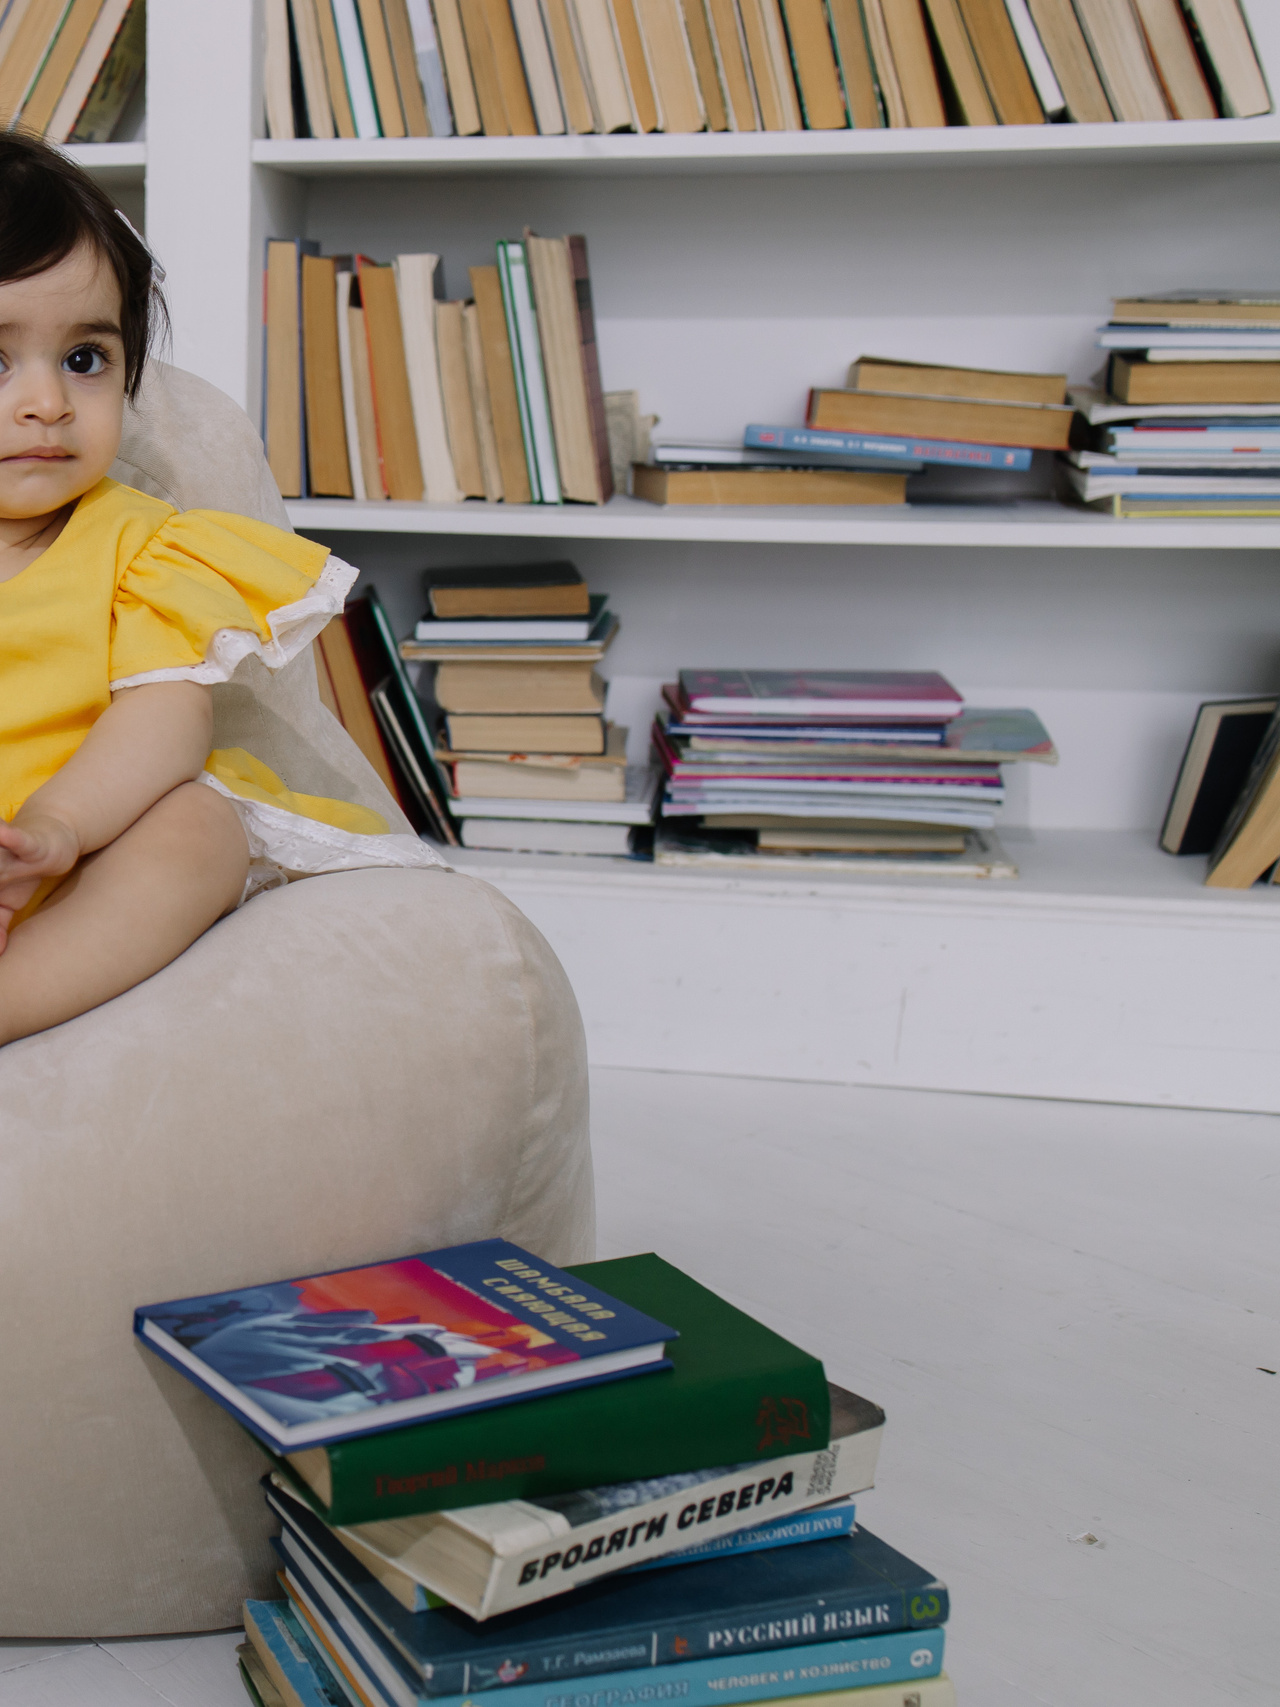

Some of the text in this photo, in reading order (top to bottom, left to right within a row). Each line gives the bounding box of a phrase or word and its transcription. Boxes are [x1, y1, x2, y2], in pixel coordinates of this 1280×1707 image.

[495, 1258, 616, 1320] ШАМБАЛА
[482, 1277, 607, 1342] СИЯЮЩАЯ
[517, 1471, 794, 1587] БРОДЯГИ СЕВЕРА
[736, 1515, 843, 1547] ВАМ ПОМОЖЕТ
[708, 1603, 891, 1650] РУССКИЙ ЯЗЫК
[911, 1594, 941, 1620] 3
[545, 1680, 690, 1707] ГЕОГРАФИЯ
[708, 1671, 779, 1691] ЧЕЛОВЕК
[783, 1669, 796, 1681] И
